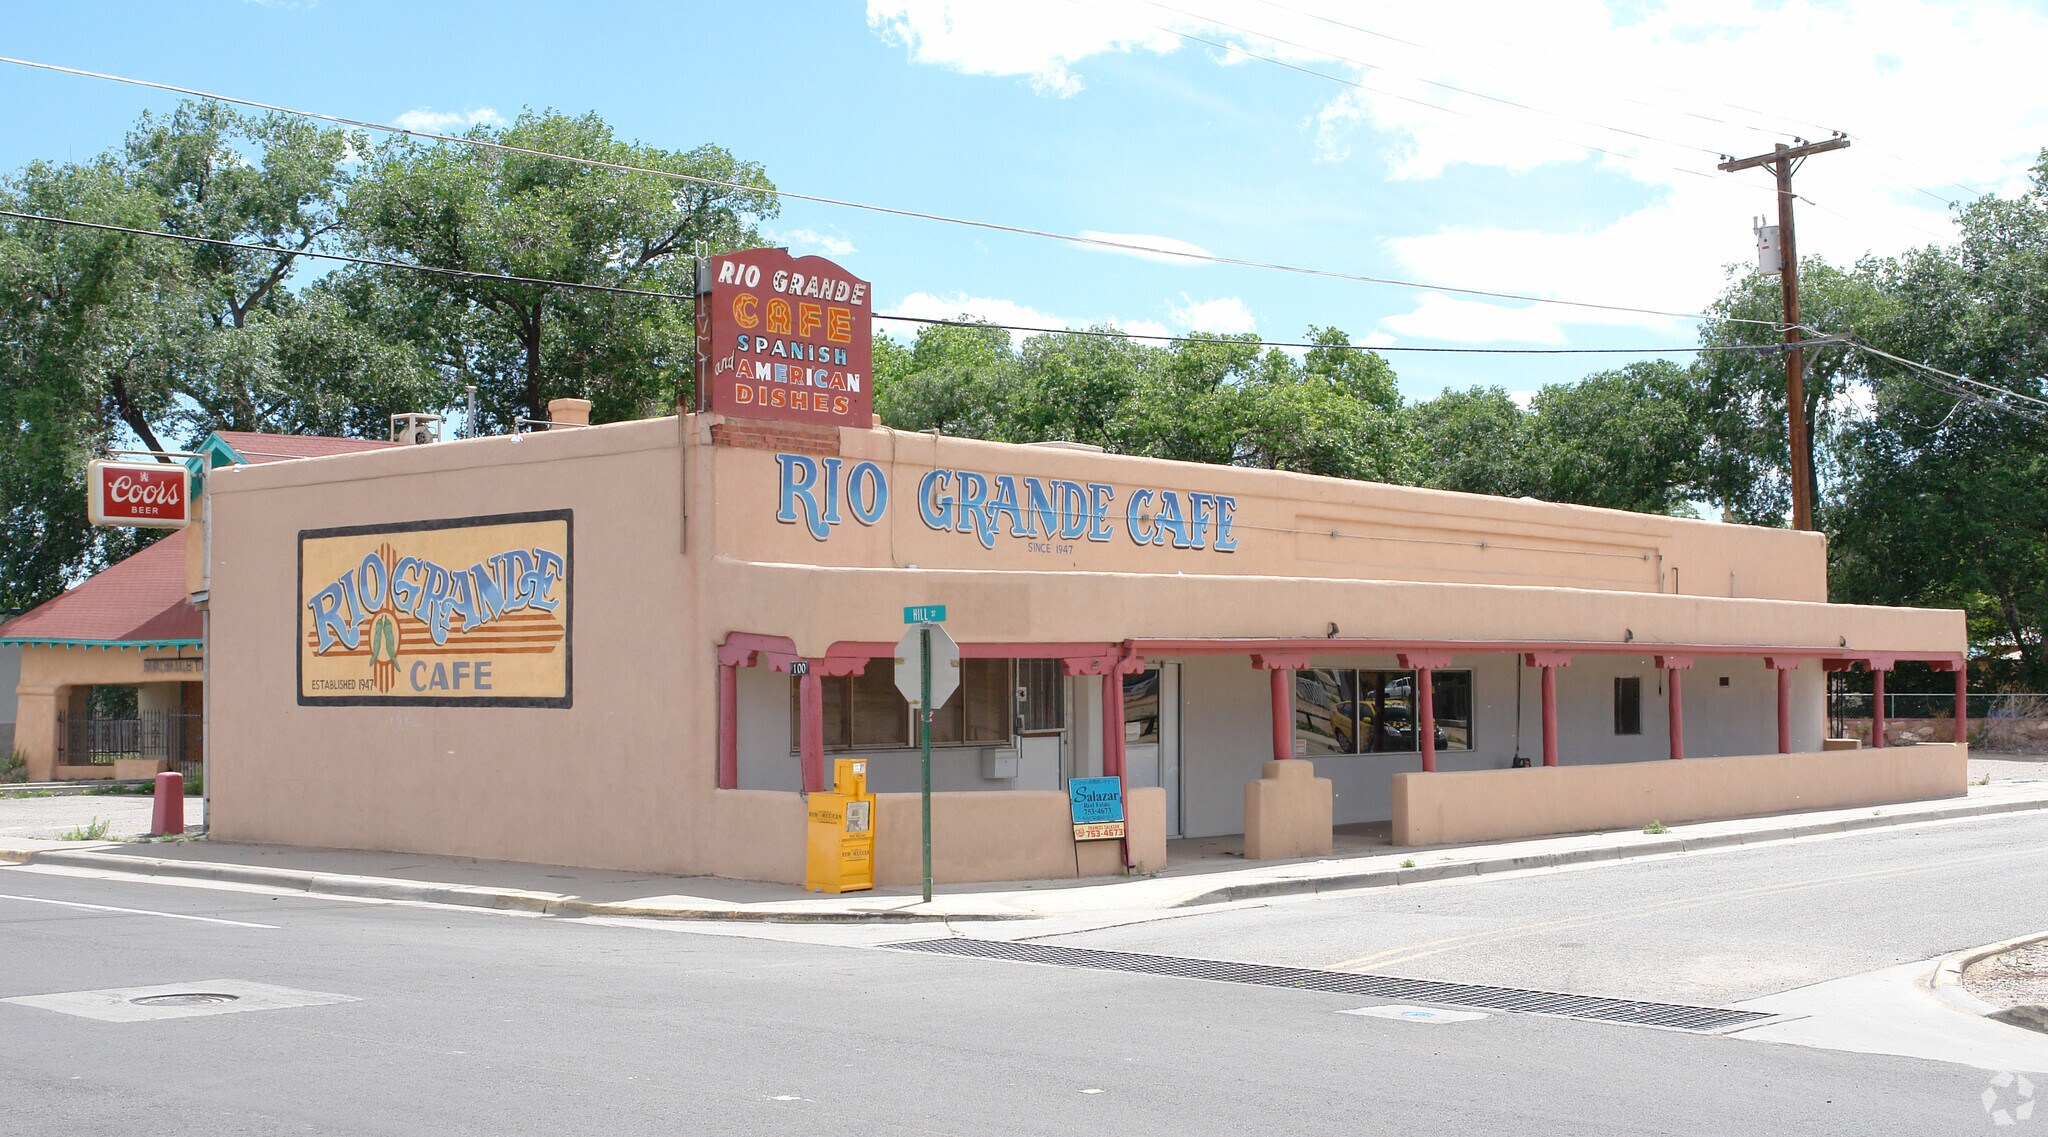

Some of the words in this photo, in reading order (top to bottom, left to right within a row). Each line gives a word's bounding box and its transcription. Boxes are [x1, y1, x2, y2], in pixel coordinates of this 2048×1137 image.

[718, 260, 761, 288] RIO
[772, 270, 867, 306] GRANDE
[732, 292, 852, 344] CAFE
[737, 334, 848, 366] SPANISH
[714, 350, 735, 376] and
[736, 359, 861, 393] AMERICAN
[735, 383, 849, 415] DISHES
[108, 475, 180, 505] Coors
[776, 453, 888, 541] RIO
[918, 469, 1115, 550] GRANDE
[1126, 487, 1239, 553] CAFE
[131, 506, 159, 515] BEER
[1028, 542, 1051, 554] SINCE
[1056, 543, 1074, 555] 1947
[307, 552, 387, 658] RIO
[391, 547, 565, 646] GRANDE
[912, 608, 929, 621] HILL
[409, 660, 493, 692] CAFE
[793, 663, 806, 674] 100
[312, 679, 356, 690] ESTABLISHED
[358, 679, 374, 691] 1947
[1074, 786, 1119, 803] Salazar
[1086, 828, 1123, 838] 753-4673
